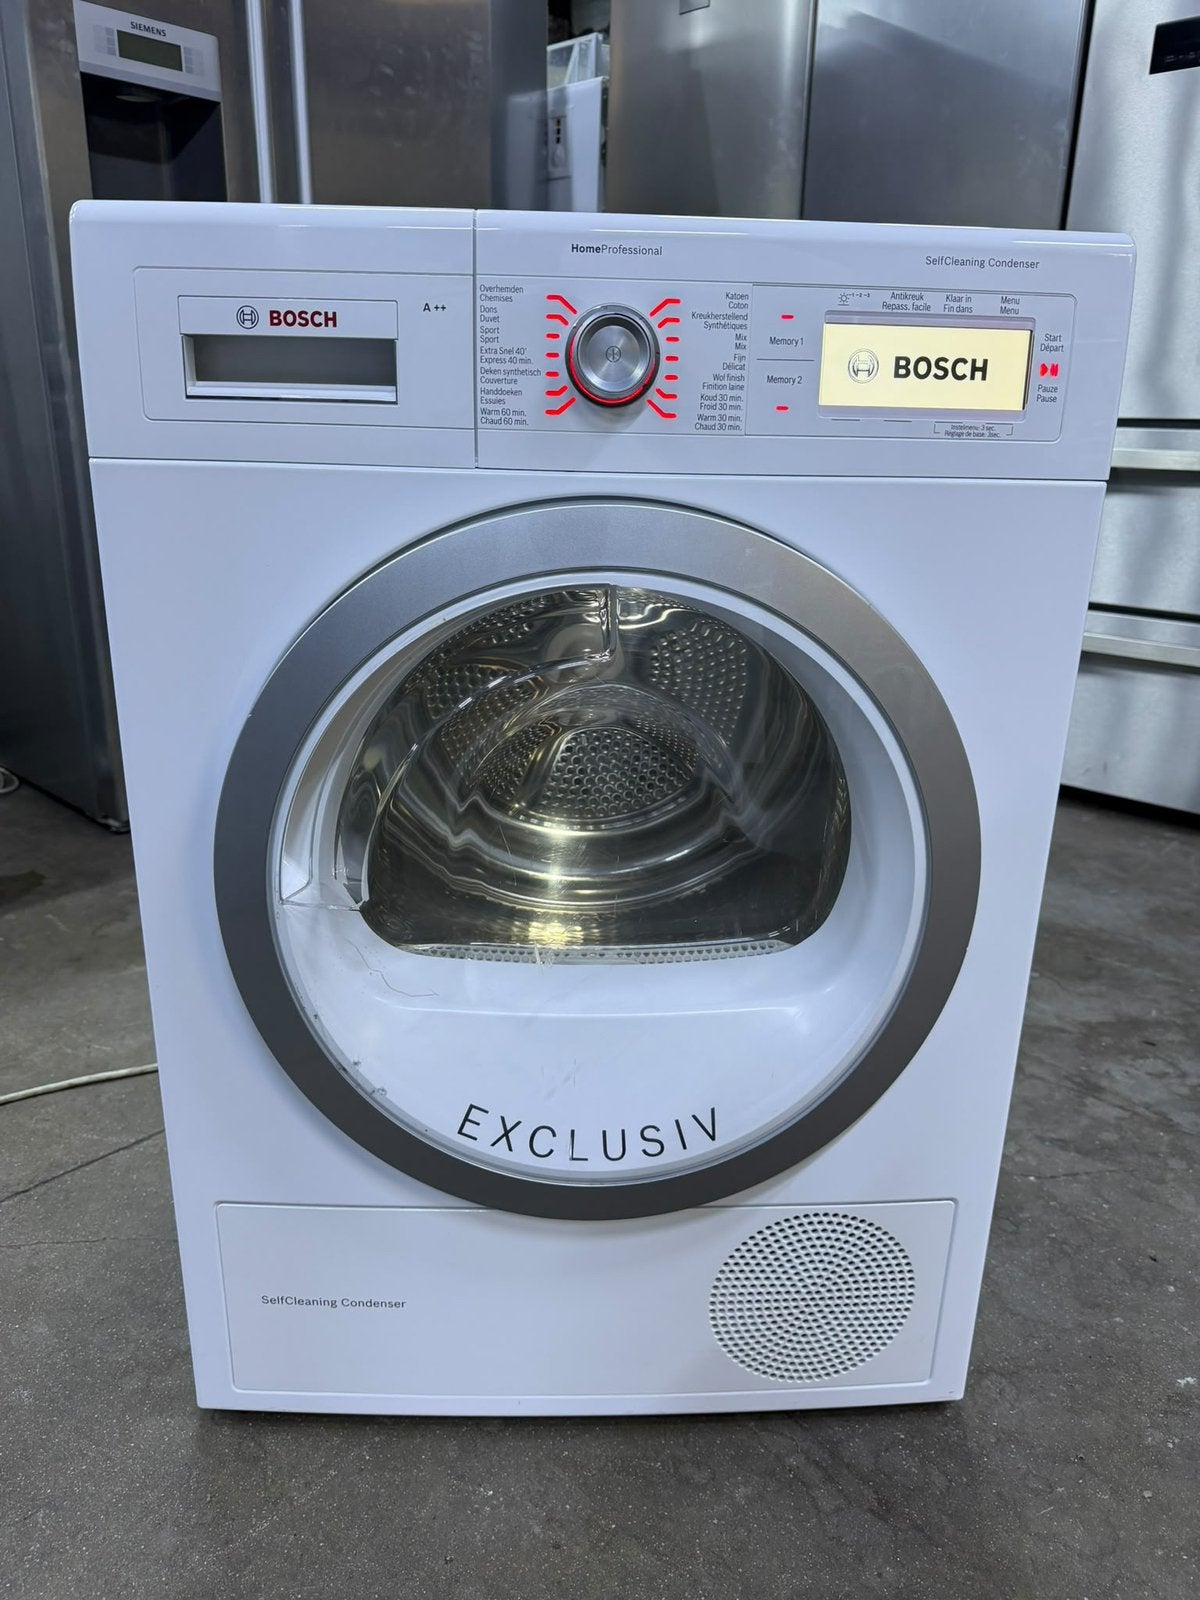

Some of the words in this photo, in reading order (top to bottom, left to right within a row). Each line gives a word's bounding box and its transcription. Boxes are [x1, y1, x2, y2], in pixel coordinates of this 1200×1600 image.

[130, 21, 167, 37] SIEMENS
[571, 243, 663, 256] HomeProfessional
[925, 255, 985, 269] SelfCleaning
[988, 257, 1040, 269] Condenser
[479, 284, 524, 294] Overhemden
[479, 293, 513, 303] Chemises
[725, 292, 749, 301] Katoen
[890, 292, 924, 301] Antikreuk
[945, 294, 965, 303] Klaar
[965, 295, 972, 303] in
[1000, 296, 1020, 305] Menu
[480, 305, 498, 314] Dons
[728, 301, 749, 310] Coton
[882, 302, 910, 312] Repass.
[911, 303, 931, 313] facile
[943, 304, 955, 313] Fin
[955, 304, 973, 313] dans
[1000, 305, 1019, 315] Menu
[269, 310, 338, 328] BOSCH
[480, 314, 500, 323] Duvet
[691, 311, 748, 321] Kreukherstellend
[480, 325, 500, 335] Sport
[703, 320, 748, 331] Synthétiques
[480, 335, 500, 344] Sport
[735, 333, 747, 342] Mix
[769, 336, 799, 347] Memory
[1044, 333, 1061, 342] Start
[480, 346, 498, 355] Extra
[499, 347, 514, 355] Snel
[735, 342, 747, 350] Mix
[1040, 343, 1064, 353] Départ
[480, 355, 507, 364] Express
[508, 356, 518, 364] 40
[519, 357, 534, 365] min.
[733, 354, 746, 363] Fijn
[480, 366, 502, 375] Deken
[503, 367, 542, 377] synthetisch
[722, 362, 746, 371] Délicat
[893, 355, 989, 381] BOSCH
[480, 376, 519, 385] Couverture
[713, 374, 726, 382] Wol
[726, 374, 745, 382] finish
[766, 375, 796, 386] Memory
[797, 376, 803, 384] 2
[480, 387, 523, 397] Handdoeken
[702, 382, 728, 391] Finition
[728, 383, 745, 392] laine
[1037, 384, 1058, 393] Pauze
[480, 396, 506, 405] Essuies
[700, 394, 718, 402] Koud
[718, 394, 728, 402] 30
[728, 394, 744, 403] min.
[1036, 394, 1057, 403] Pause
[699, 402, 717, 411] Froid
[718, 403, 728, 411] 30
[728, 403, 743, 411] min.
[480, 407, 501, 416] Warm
[501, 408, 511, 416] 60
[512, 409, 527, 417] min.
[480, 416, 503, 425] Chaud
[503, 417, 513, 425] 60
[514, 417, 529, 426] min.
[697, 413, 717, 421] Warm
[717, 414, 727, 422] 30
[727, 414, 743, 423] min.
[694, 422, 716, 431] Chaud
[717, 423, 727, 431] 30
[727, 423, 743, 432] min.
[457, 1103, 716, 1161] EXCLUSIV
[261, 1295, 338, 1309] SelfCleaning
[341, 1297, 406, 1308] Condenser
